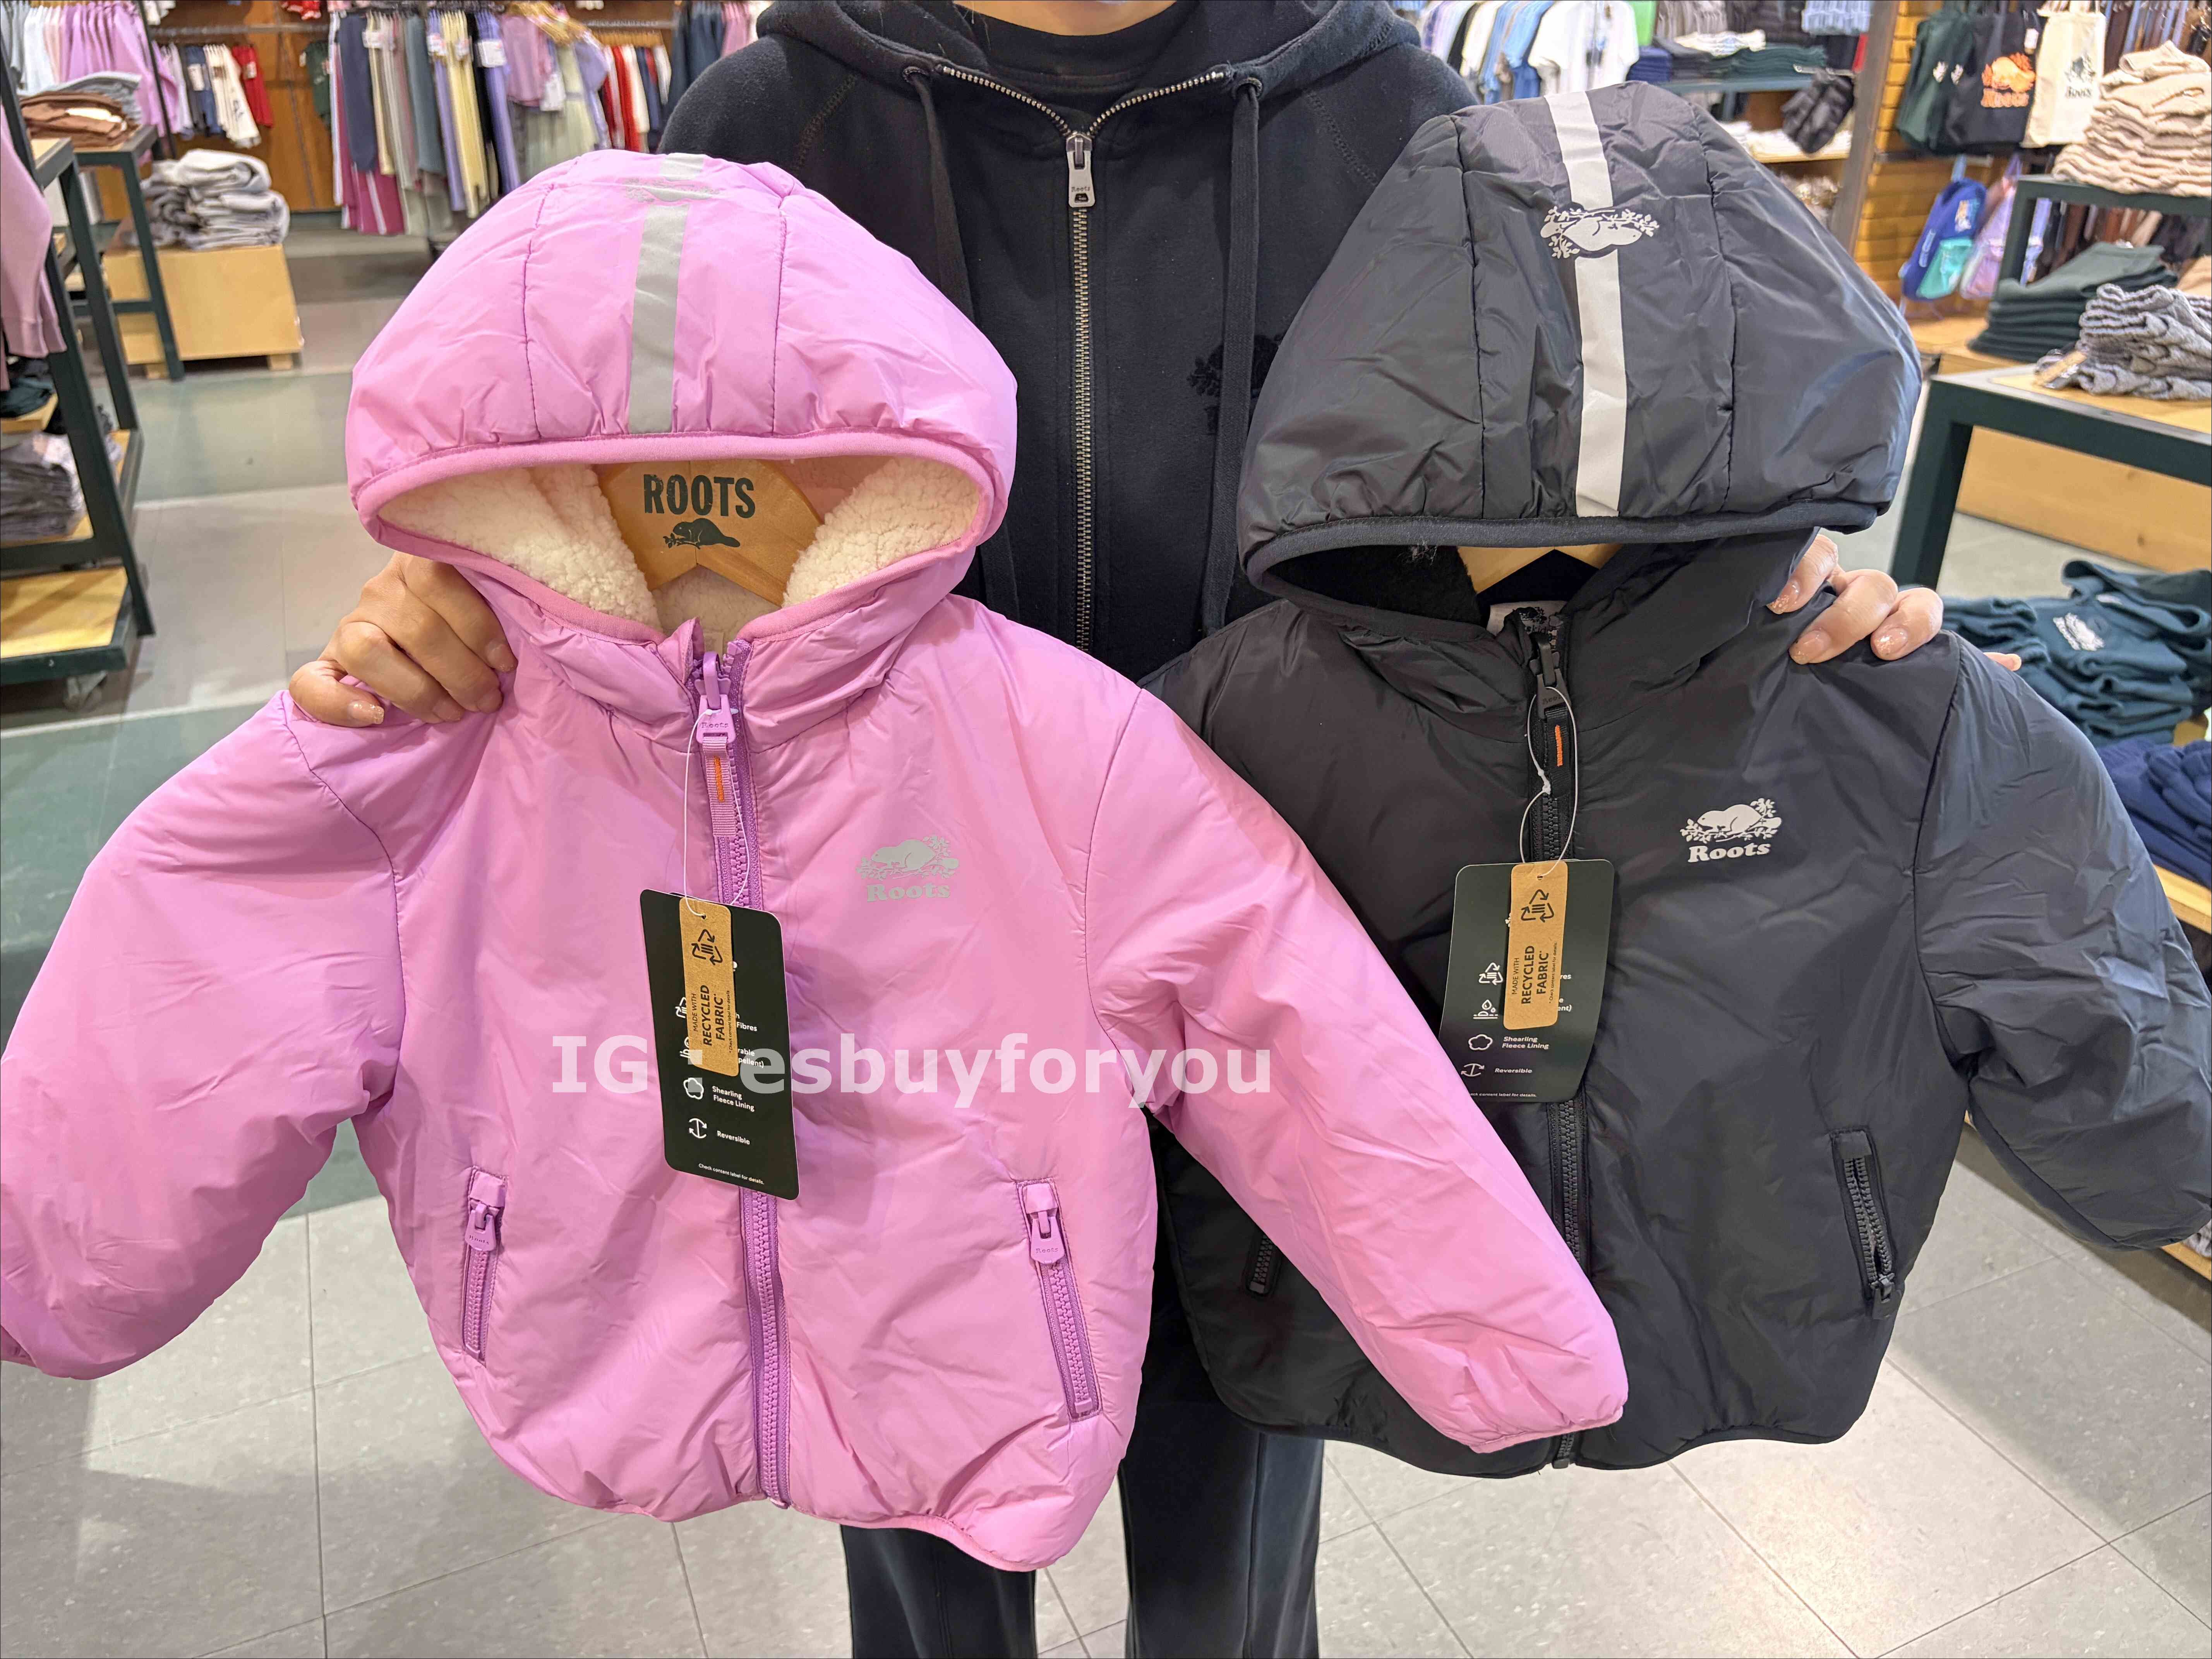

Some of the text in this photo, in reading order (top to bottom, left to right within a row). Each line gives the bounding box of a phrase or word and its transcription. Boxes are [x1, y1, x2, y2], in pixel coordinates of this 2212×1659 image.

[643, 474, 756, 519] ROOTS
[1687, 842, 1771, 863] Roots
[867, 882, 951, 903] Roots
[1521, 946, 1535, 1004] RECYCLED
[700, 985, 712, 1046] RECYCLED
[736, 1021, 758, 1032] Fibres
[738, 1048, 755, 1056] rable
[712, 1085, 742, 1101] Shearling
[713, 1095, 755, 1112] Fleece Lining
[717, 1130, 750, 1145] Reversible
[698, 1163, 712, 1171] Check
[713, 1167, 730, 1176] content
